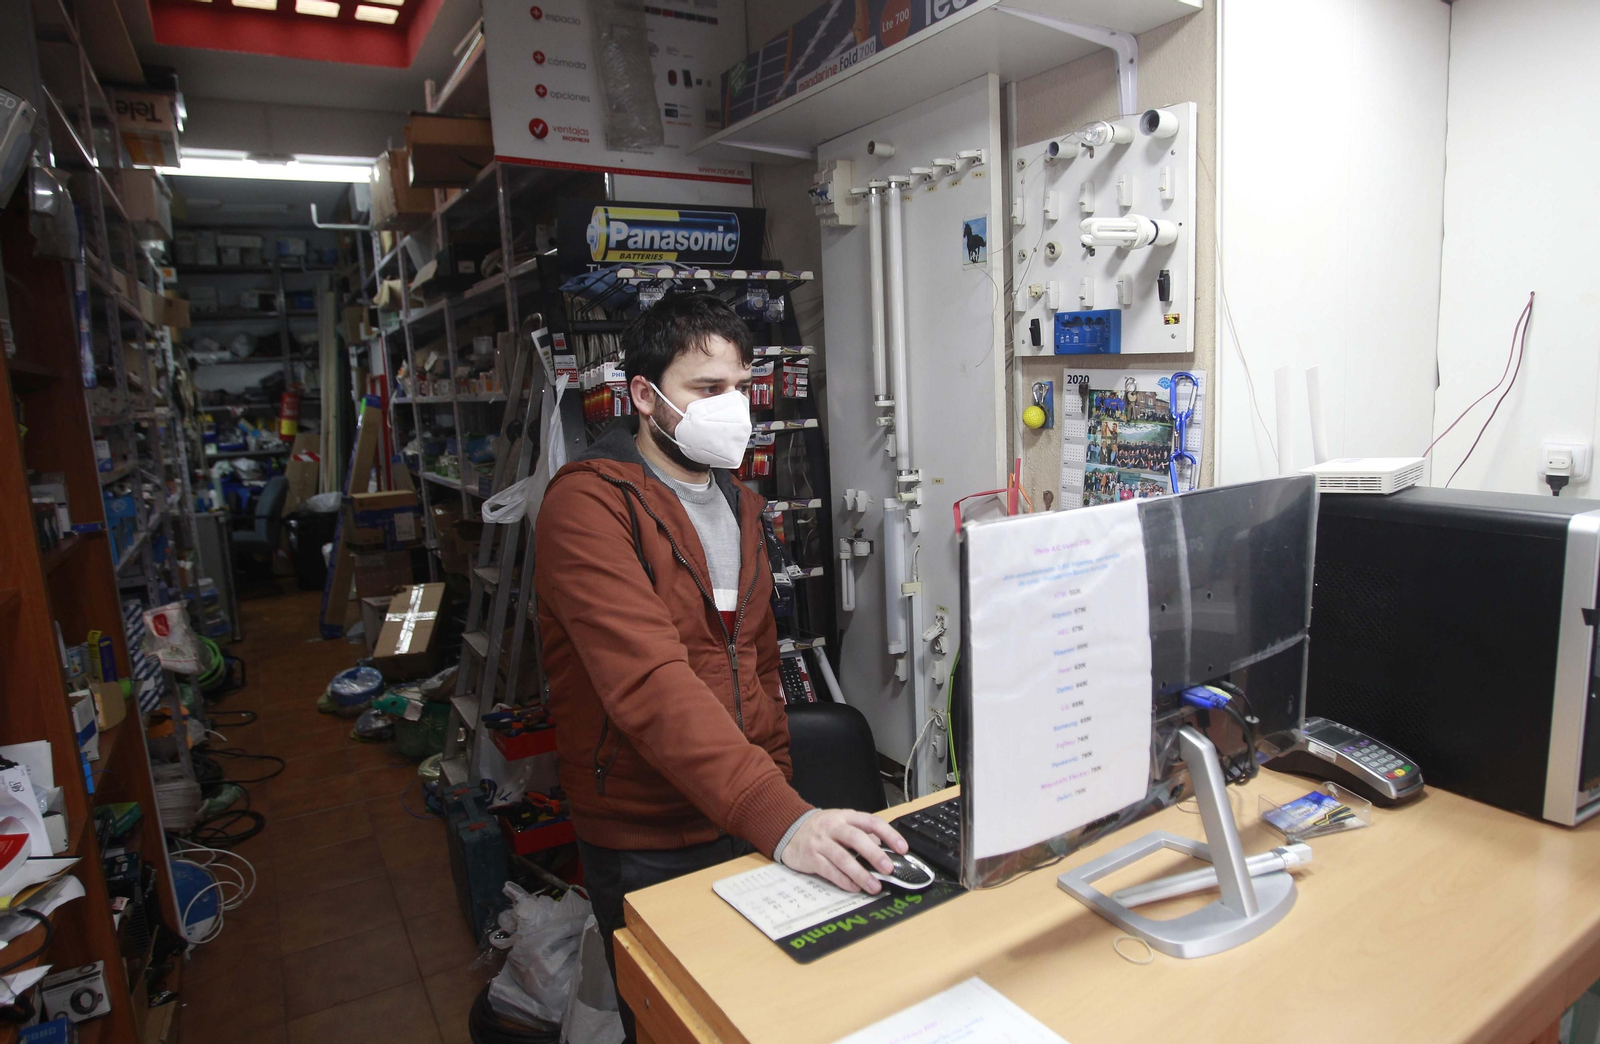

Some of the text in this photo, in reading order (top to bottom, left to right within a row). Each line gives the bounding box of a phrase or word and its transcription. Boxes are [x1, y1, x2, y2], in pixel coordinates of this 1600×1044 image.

[545, 13, 581, 26] espacio
[882, 8, 909, 33] Lte 700
[548, 56, 587, 70] cómoda
[798, 39, 875, 92] mandarine Fold 700
[550, 90, 591, 103] opciones
[552, 124, 590, 137] ventajas
[608, 221, 737, 251] Panasonic
[618, 252, 664, 261] BATTERIES
[1067, 374, 1090, 385] 2020
[789, 893, 922, 949] Split Mania
